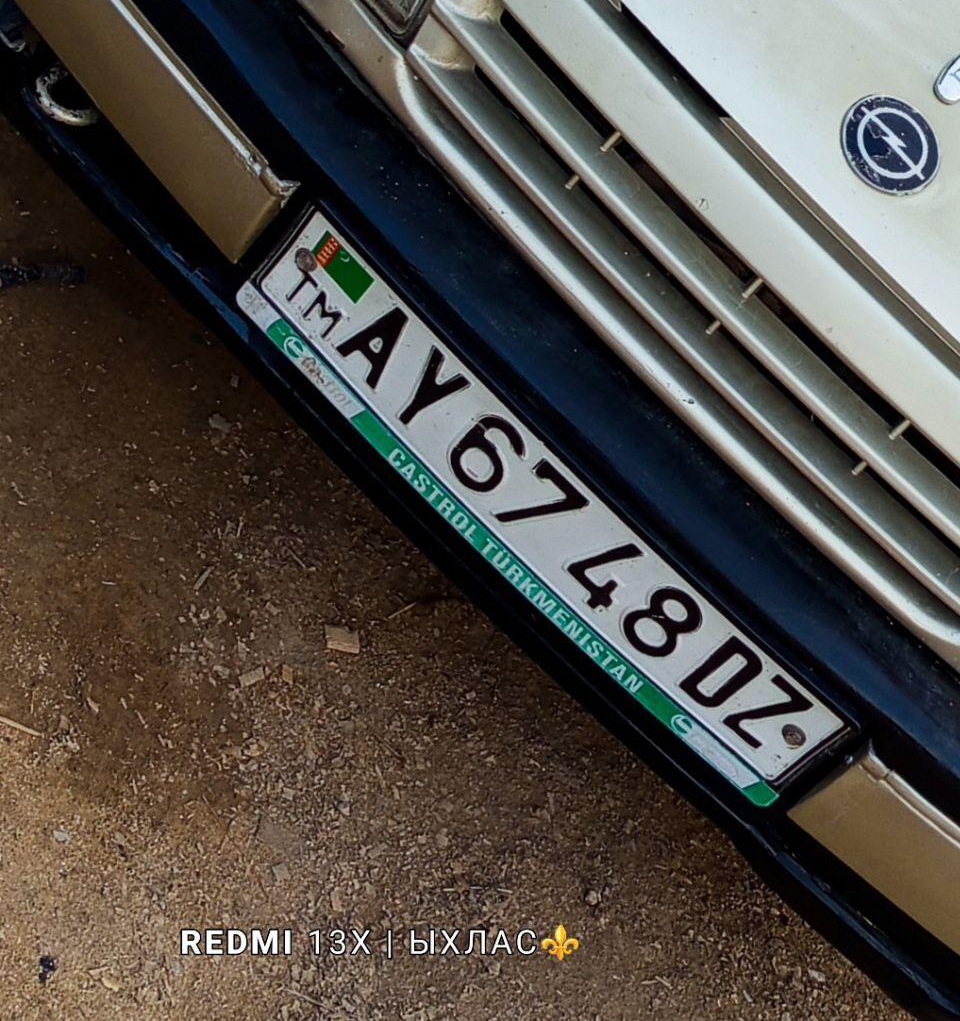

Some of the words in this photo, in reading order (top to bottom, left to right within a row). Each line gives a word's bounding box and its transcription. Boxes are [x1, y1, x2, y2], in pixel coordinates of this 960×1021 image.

[285, 270, 342, 338] TM
[388, 448, 477, 543] CASTROL
[482, 537, 643, 694] TÜRKMENISTAN
